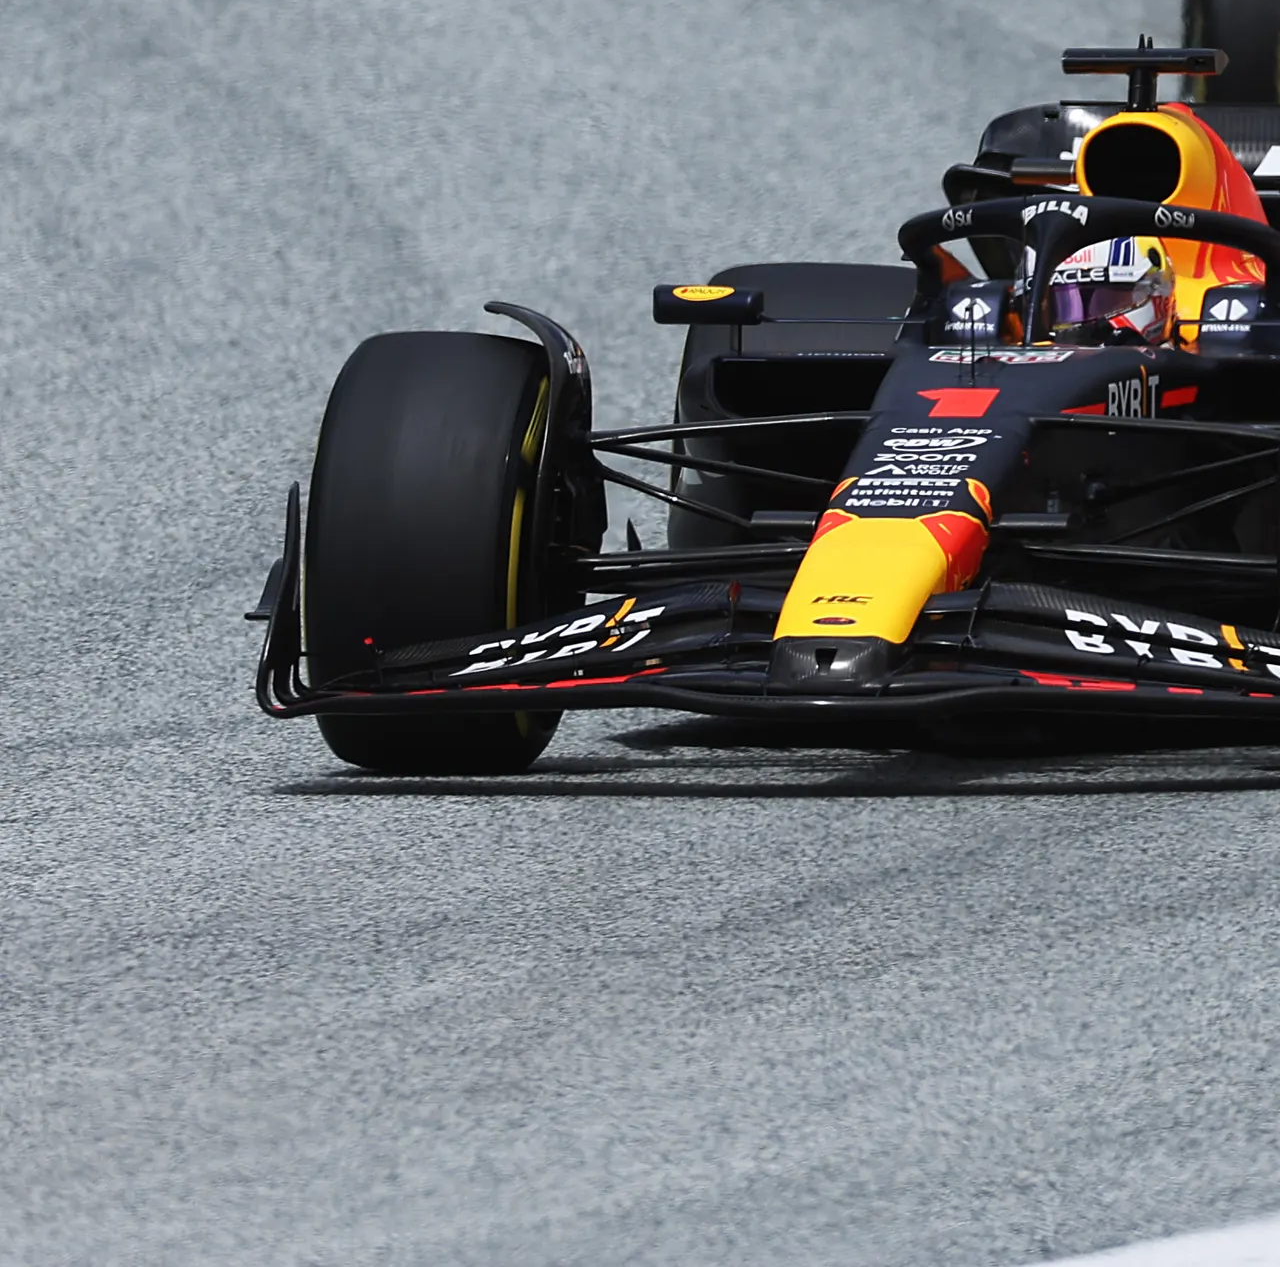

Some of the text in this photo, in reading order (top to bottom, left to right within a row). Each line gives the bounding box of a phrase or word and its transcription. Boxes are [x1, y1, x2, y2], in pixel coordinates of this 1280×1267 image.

[1021, 201, 1088, 227] BILLA
[917, 387, 1000, 418] 1
[947, 427, 993, 435] App
[883, 437, 972, 449] CDW
[857, 478, 961, 487] PIRELLI
[845, 498, 920, 507] Mobil
[811, 595, 874, 606] HRC
